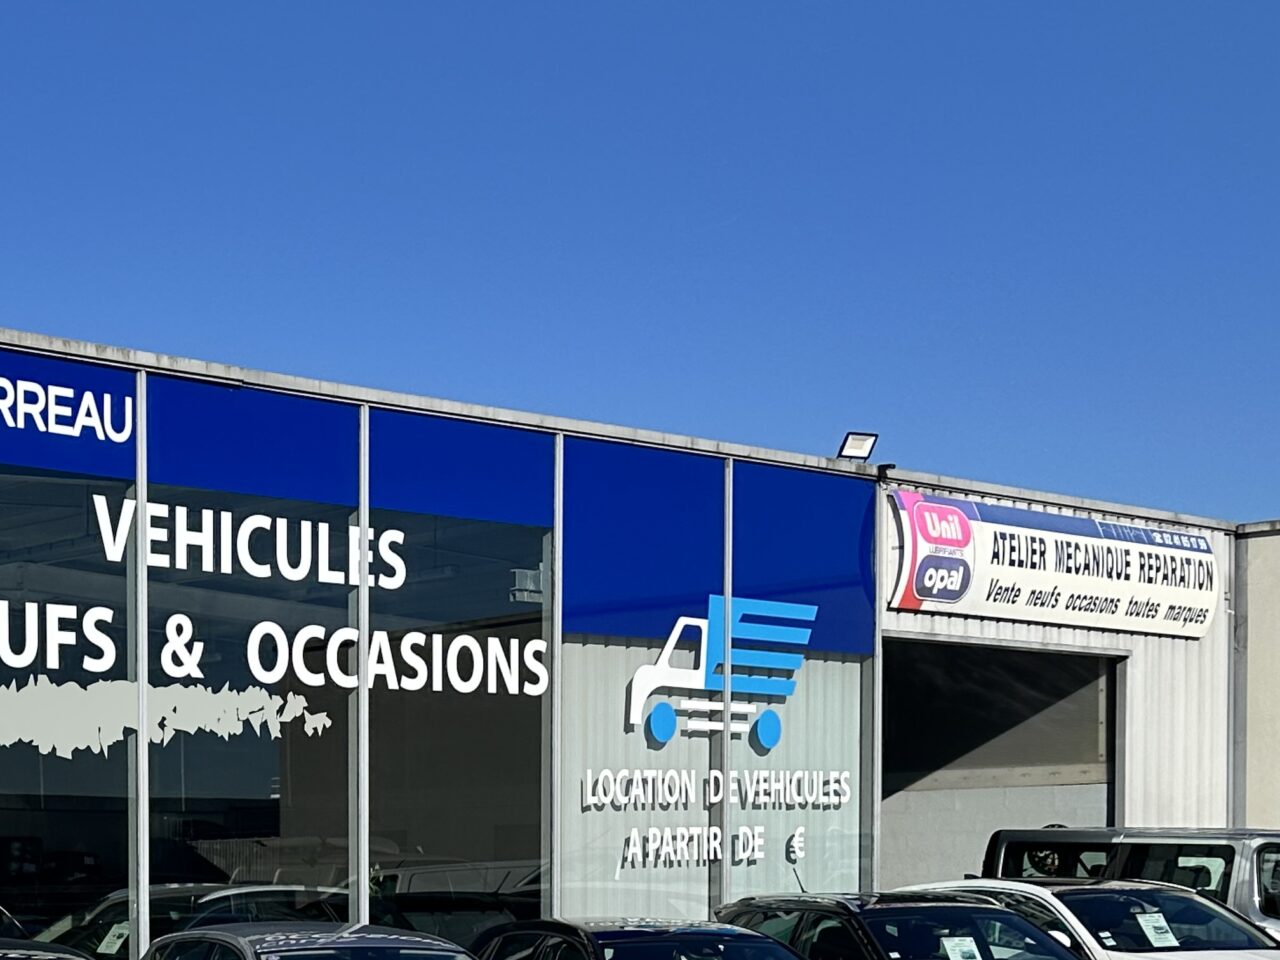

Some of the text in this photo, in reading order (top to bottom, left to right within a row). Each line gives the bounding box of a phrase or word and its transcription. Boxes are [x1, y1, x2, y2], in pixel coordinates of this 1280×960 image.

[91, 493, 407, 591] VEHICULES
[923, 511, 963, 541] Unil
[923, 566, 964, 595] opal
[990, 531, 1047, 571] ATELIER
[1054, 539, 1131, 581] MECANIQUE
[1138, 551, 1214, 592] REPARATION
[985, 578, 1209, 628] Vente neufs occasions toutes marques
[160, 613, 205, 680] &
[246, 621, 550, 697] OCCASIONS
[586, 768, 851, 804] LOCATION DE VEHICULES
[627, 825, 806, 862] A PARTIR DE €
